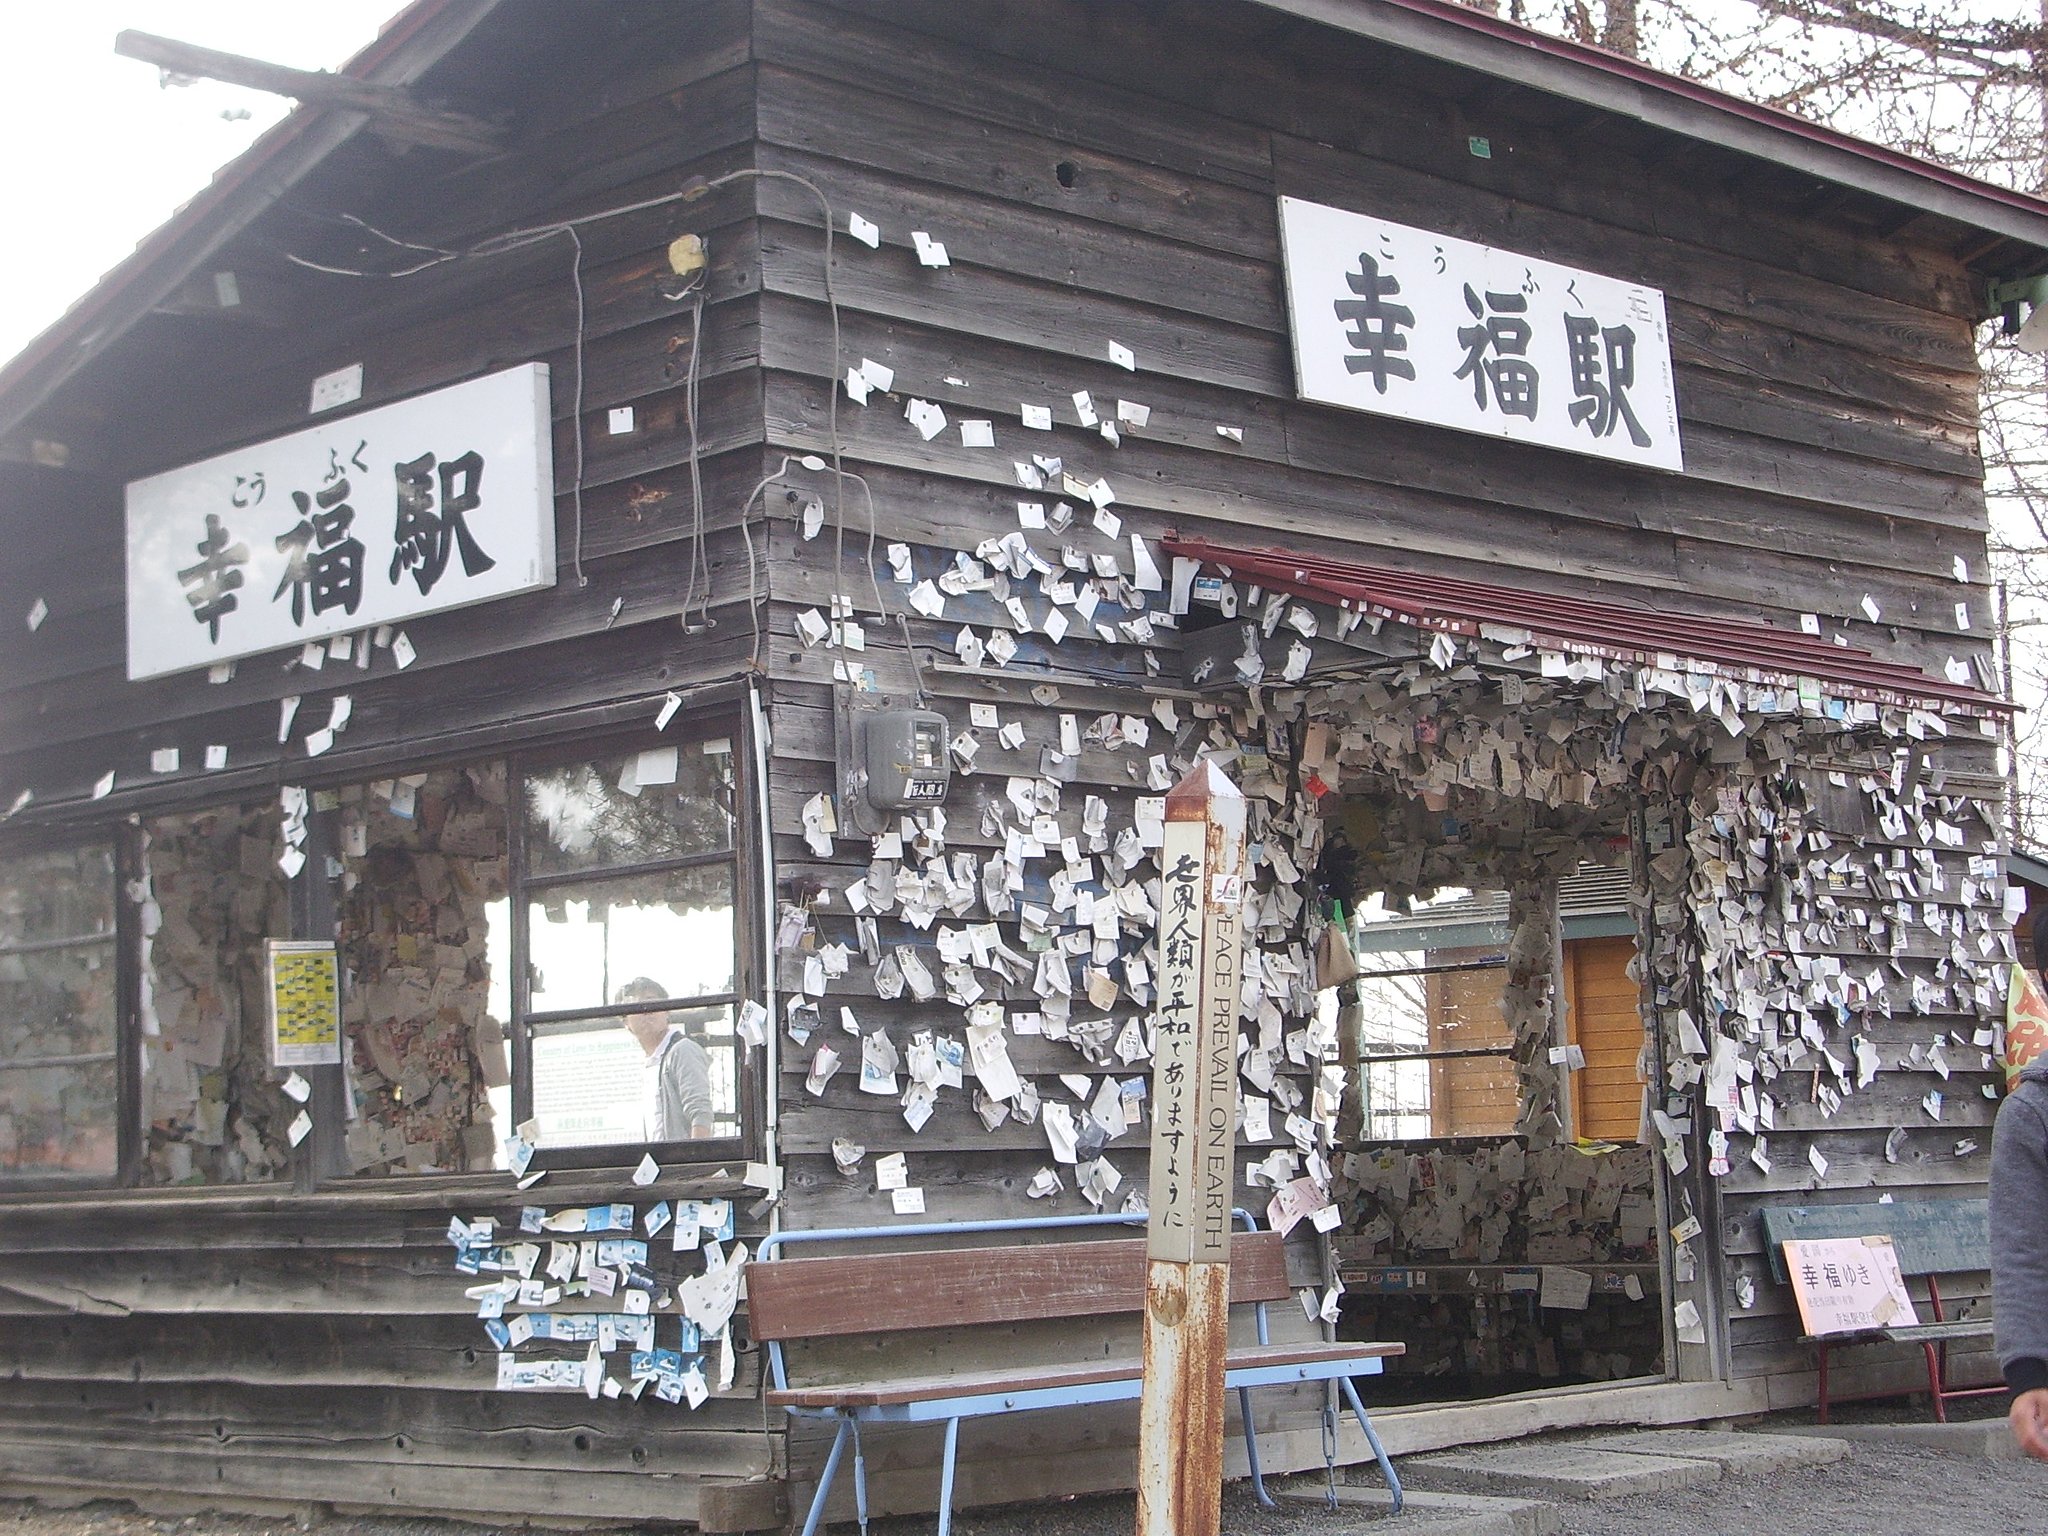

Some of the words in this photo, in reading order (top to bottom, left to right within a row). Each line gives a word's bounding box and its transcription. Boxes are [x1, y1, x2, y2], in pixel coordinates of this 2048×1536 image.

[1379, 233, 1585, 309] こうふく
[1333, 252, 1653, 448] 幸福駅
[232, 439, 370, 508] こうふく
[177, 451, 497, 645] 幸福駅
[1158, 854, 1202, 1227] 世界人類が平和でありますように
[1210, 997, 1231, 1102] PREVAIL
[1208, 1107, 1228, 1148] ON
[1204, 1156, 1226, 1248] EARTH
[1802, 1263, 1872, 1290] 幸福ゆき
